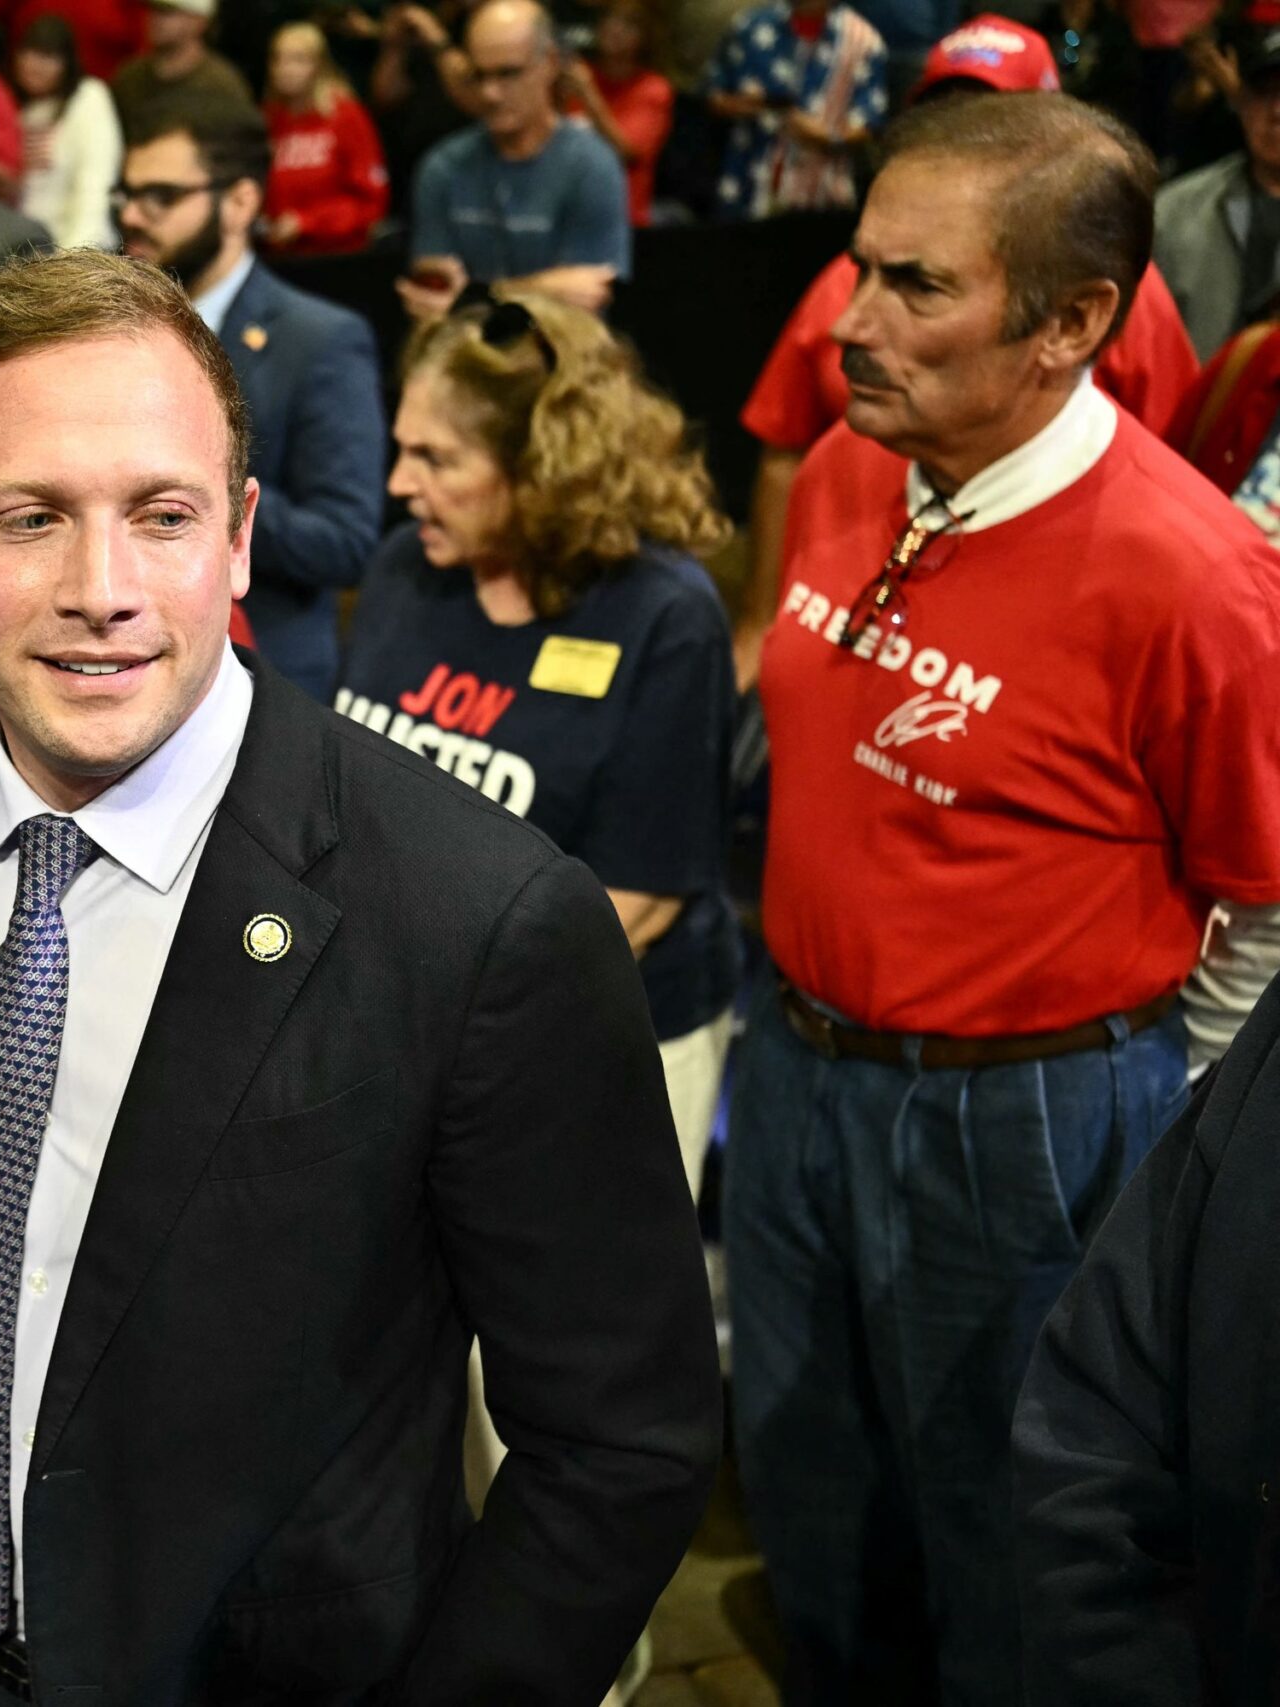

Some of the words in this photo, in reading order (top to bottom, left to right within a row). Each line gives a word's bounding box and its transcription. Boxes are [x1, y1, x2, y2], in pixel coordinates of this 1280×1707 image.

[783, 580, 1003, 714] FREEDOM
[399, 663, 517, 737] JON
[913, 773, 959, 807] KIRK
